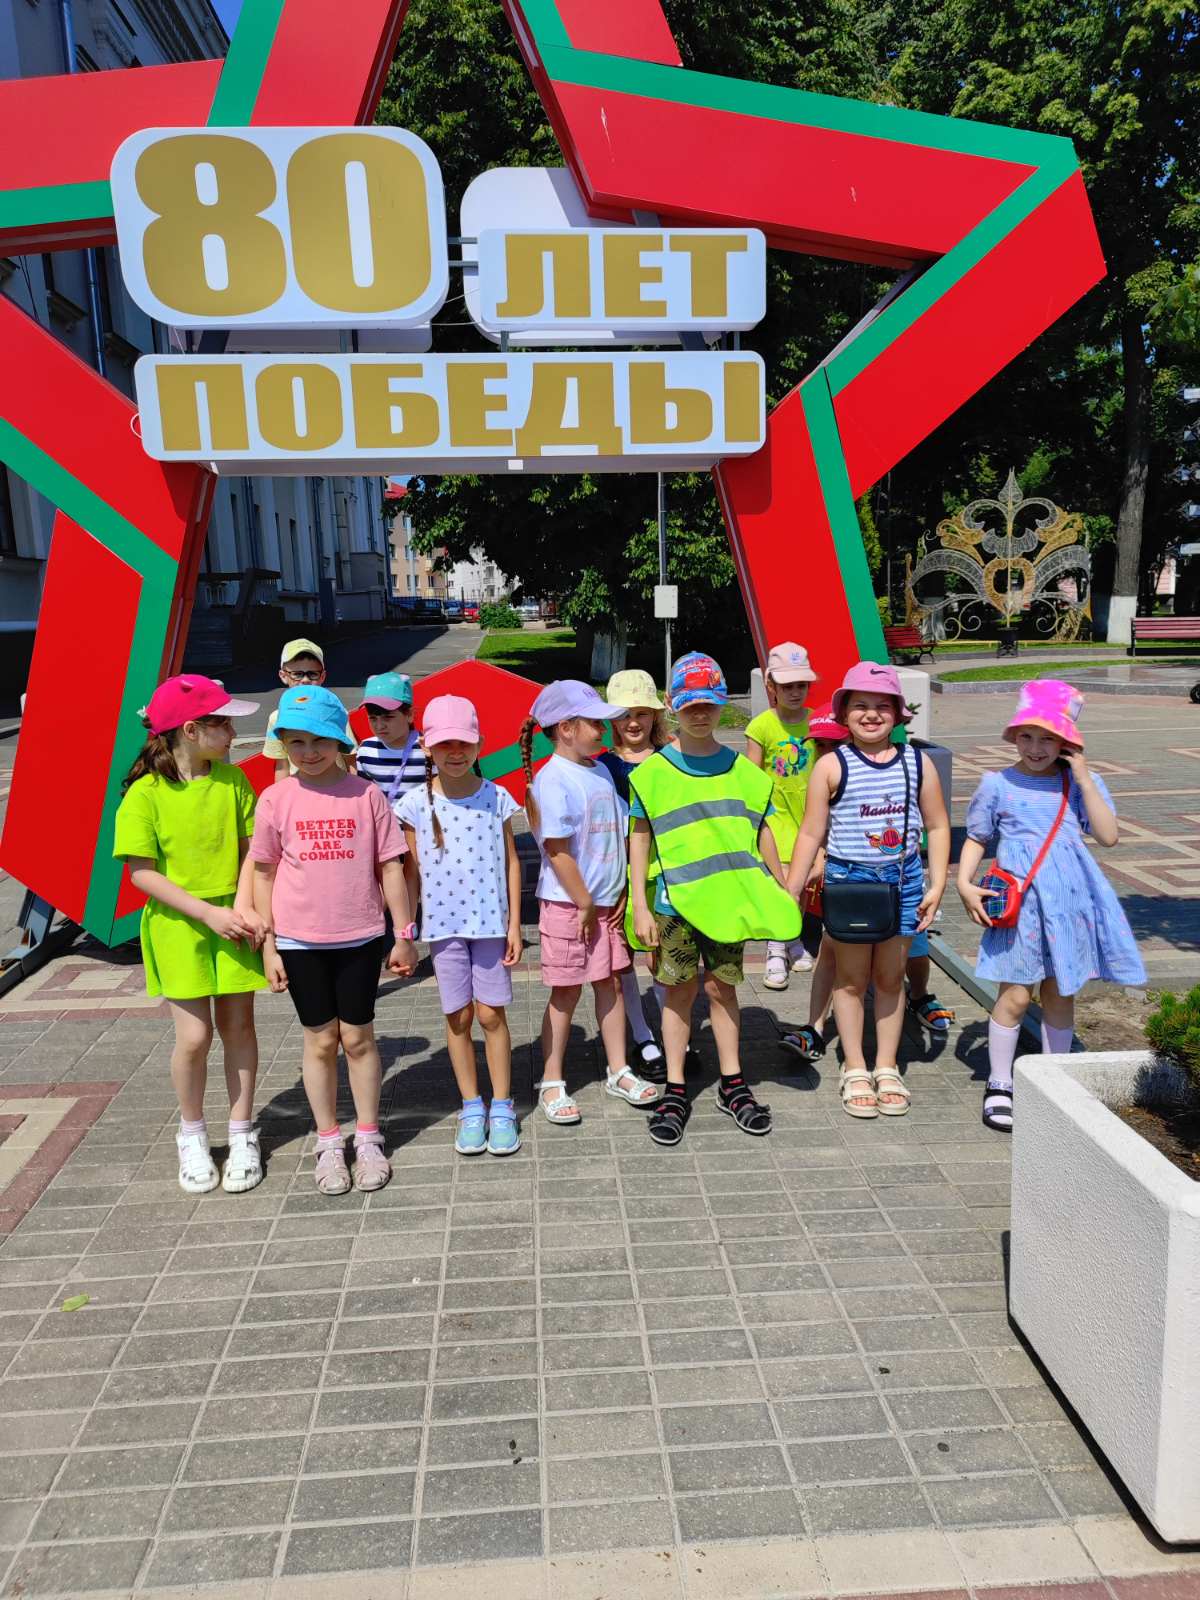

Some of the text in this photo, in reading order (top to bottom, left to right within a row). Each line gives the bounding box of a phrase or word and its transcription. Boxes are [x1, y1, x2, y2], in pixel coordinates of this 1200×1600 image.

[134, 133, 748, 318] 80 ЛЕТ
[155, 361, 761, 456] ПОБЕДЫ
[295, 818, 356, 831] BETTER
[298, 830, 354, 840] THINGS
[312, 840, 342, 850] ARE
[299, 850, 354, 861] COMING
